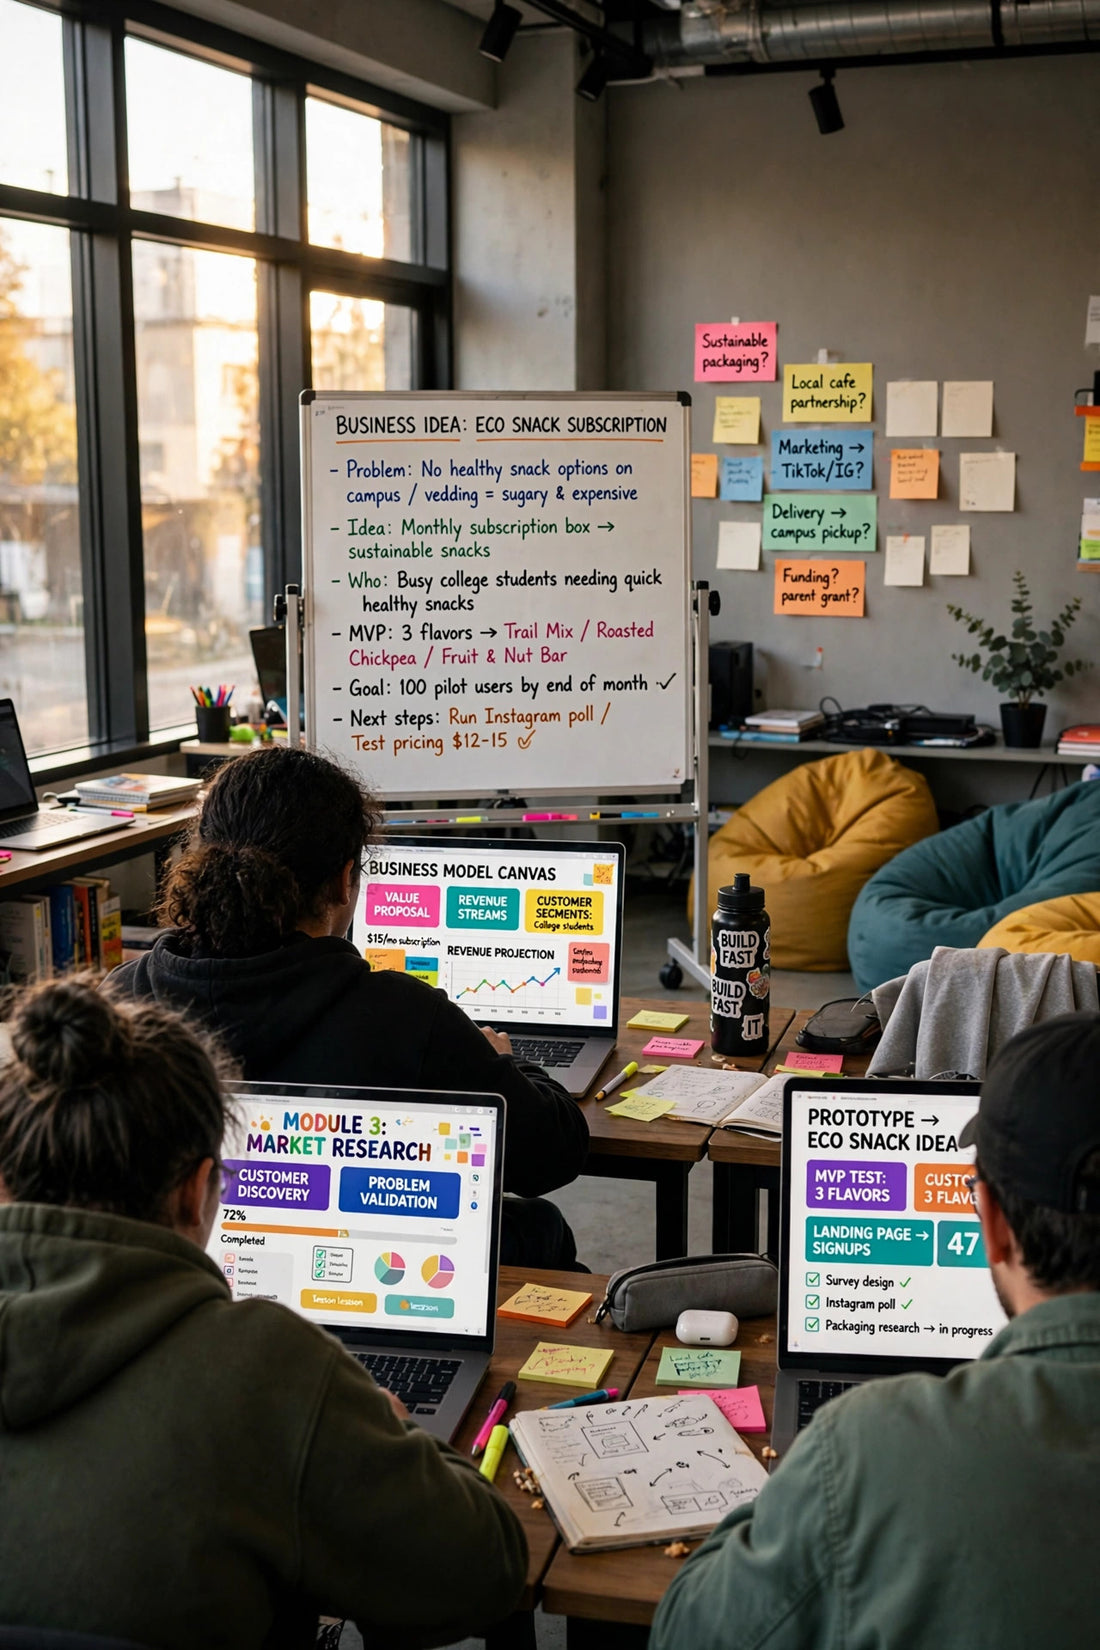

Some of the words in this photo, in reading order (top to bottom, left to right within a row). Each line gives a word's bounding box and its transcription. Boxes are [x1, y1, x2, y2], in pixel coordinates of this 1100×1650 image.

[703, 332, 768, 348] Sustainable
[703, 351, 769, 373] packaging?
[792, 374, 823, 389] Local
[830, 373, 856, 389] cafe
[791, 392, 866, 413] partnership?
[336, 415, 416, 435] BUSINESS
[424, 416, 467, 433] IDEA:
[476, 416, 505, 433] ECO
[512, 416, 560, 433] SNACK
[568, 417, 667, 433] SUBSCRIPTION
[779, 439, 843, 461] Marketing
[347, 459, 411, 478] Problem:
[422, 459, 441, 477] No
[450, 458, 502, 483] healthy
[510, 459, 550, 476] snack
[558, 459, 608, 481] options
[616, 464, 632, 475] on
[781, 460, 864, 482] TikTok/IG?
[347, 491, 400, 508] campus
[408, 483, 417, 506] /
[425, 485, 478, 508] vedding
[502, 490, 548, 508] sugary
[556, 486, 564, 500] &
[572, 489, 638, 506] expensive
[772, 503, 825, 526] Delivery
[347, 518, 391, 536] Idea:
[402, 518, 462, 542] Monthly
[470, 518, 557, 540] subscription
[566, 517, 590, 533] box
[771, 528, 816, 544] campus
[822, 523, 871, 544] pickup?
[349, 541, 433, 559] sustainable
[441, 541, 490, 558] snacks
[348, 571, 387, 588] Who:
[397, 570, 433, 594] Busy
[440, 570, 488, 594] college
[496, 569, 557, 587] students
[565, 569, 617, 593] needing
[624, 568, 662, 592] quick
[783, 567, 839, 590] Funding?
[363, 594, 418, 619] healthy
[425, 594, 474, 611] snacks
[782, 589, 816, 606] parent
[821, 587, 859, 608] grant?
[349, 624, 392, 642] MVP:
[402, 624, 412, 641] 3
[420, 622, 472, 640] flavors
[504, 622, 537, 639] Trail
[547, 622, 573, 638] Mix
[580, 619, 590, 642] /
[597, 620, 654, 638] Roasted
[349, 649, 416, 671] Chickpea
[424, 646, 434, 669] /
[443, 647, 478, 664] Fruit
[487, 649, 495, 663] &
[505, 647, 533, 663] Nut
[541, 646, 567, 663] Bar
[350, 678, 390, 696] Goal:
[400, 679, 426, 695] 100
[435, 677, 468, 700] pilot
[475, 682, 513, 693] users
[521, 676, 539, 700] by
[547, 675, 572, 692] end
[580, 674, 596, 691] of
[603, 674, 648, 691] month
[351, 709, 387, 727] Next
[395, 709, 439, 731] steps:
[449, 707, 477, 725] Run
[485, 708, 560, 729] Instagram
[569, 705, 593, 728] poll
[601, 702, 611, 725] /
[351, 735, 385, 751] Test
[394, 735, 443, 756] pricing
[453, 732, 507, 750] $12-15
[369, 860, 438, 877] BUSINESS
[443, 864, 493, 879] MODEL
[498, 866, 556, 881] CANVAS
[385, 892, 419, 903] VALUE
[459, 895, 507, 907] REVENUE
[537, 896, 592, 907] CUSTOMER
[374, 905, 430, 918] PROPOSAL
[458, 909, 507, 921] STREAMS
[563, 922, 594, 930] students
[721, 933, 757, 949] BUILD
[447, 945, 492, 957] REVENUE
[495, 948, 555, 960] PROJECTION
[723, 950, 752, 965] FAST
[712, 979, 744, 998] BUILD
[713, 997, 740, 1016] FAST
[748, 1018, 761, 1035] IT
[283, 1112, 363, 1134] MODULE
[369, 1116, 386, 1135] 3:
[808, 1108, 915, 1128] PROTOTYPE
[247, 1133, 326, 1155] MARKET
[332, 1138, 431, 1162] RESEARCH
[808, 1131, 843, 1149] ECO
[849, 1132, 910, 1151] SNACK
[916, 1134, 958, 1152] IDEA
[239, 1169, 308, 1185] CUSTOMER
[369, 1176, 430, 1192] PROBLEM
[815, 1170, 846, 1183] MVP
[849, 1170, 886, 1184] TEST:
[924, 1173, 975, 1187] CUSTO
[238, 1185, 310, 1201] DISCOVERY
[360, 1192, 437, 1209] VALIDATION
[815, 1187, 824, 1200] 3
[828, 1187, 890, 1202] FLAVORS
[924, 1190, 932, 1203] 3
[223, 1209, 246, 1221] 72%
[221, 1234, 265, 1247] Completed
[814, 1225, 873, 1239] LANDING
[877, 1227, 911, 1241] PAGE
[813, 1241, 871, 1256] SIGNUPS
[948, 1232, 979, 1255] 47
[826, 1274, 860, 1290] Survey
[862, 1275, 894, 1291] design
[826, 1297, 875, 1312] Instagram
[878, 1298, 895, 1313] poll
[826, 1319, 875, 1335] Packaging
[879, 1322, 920, 1333] research
[939, 1323, 948, 1334] in
[952, 1327, 993, 1338] progress
